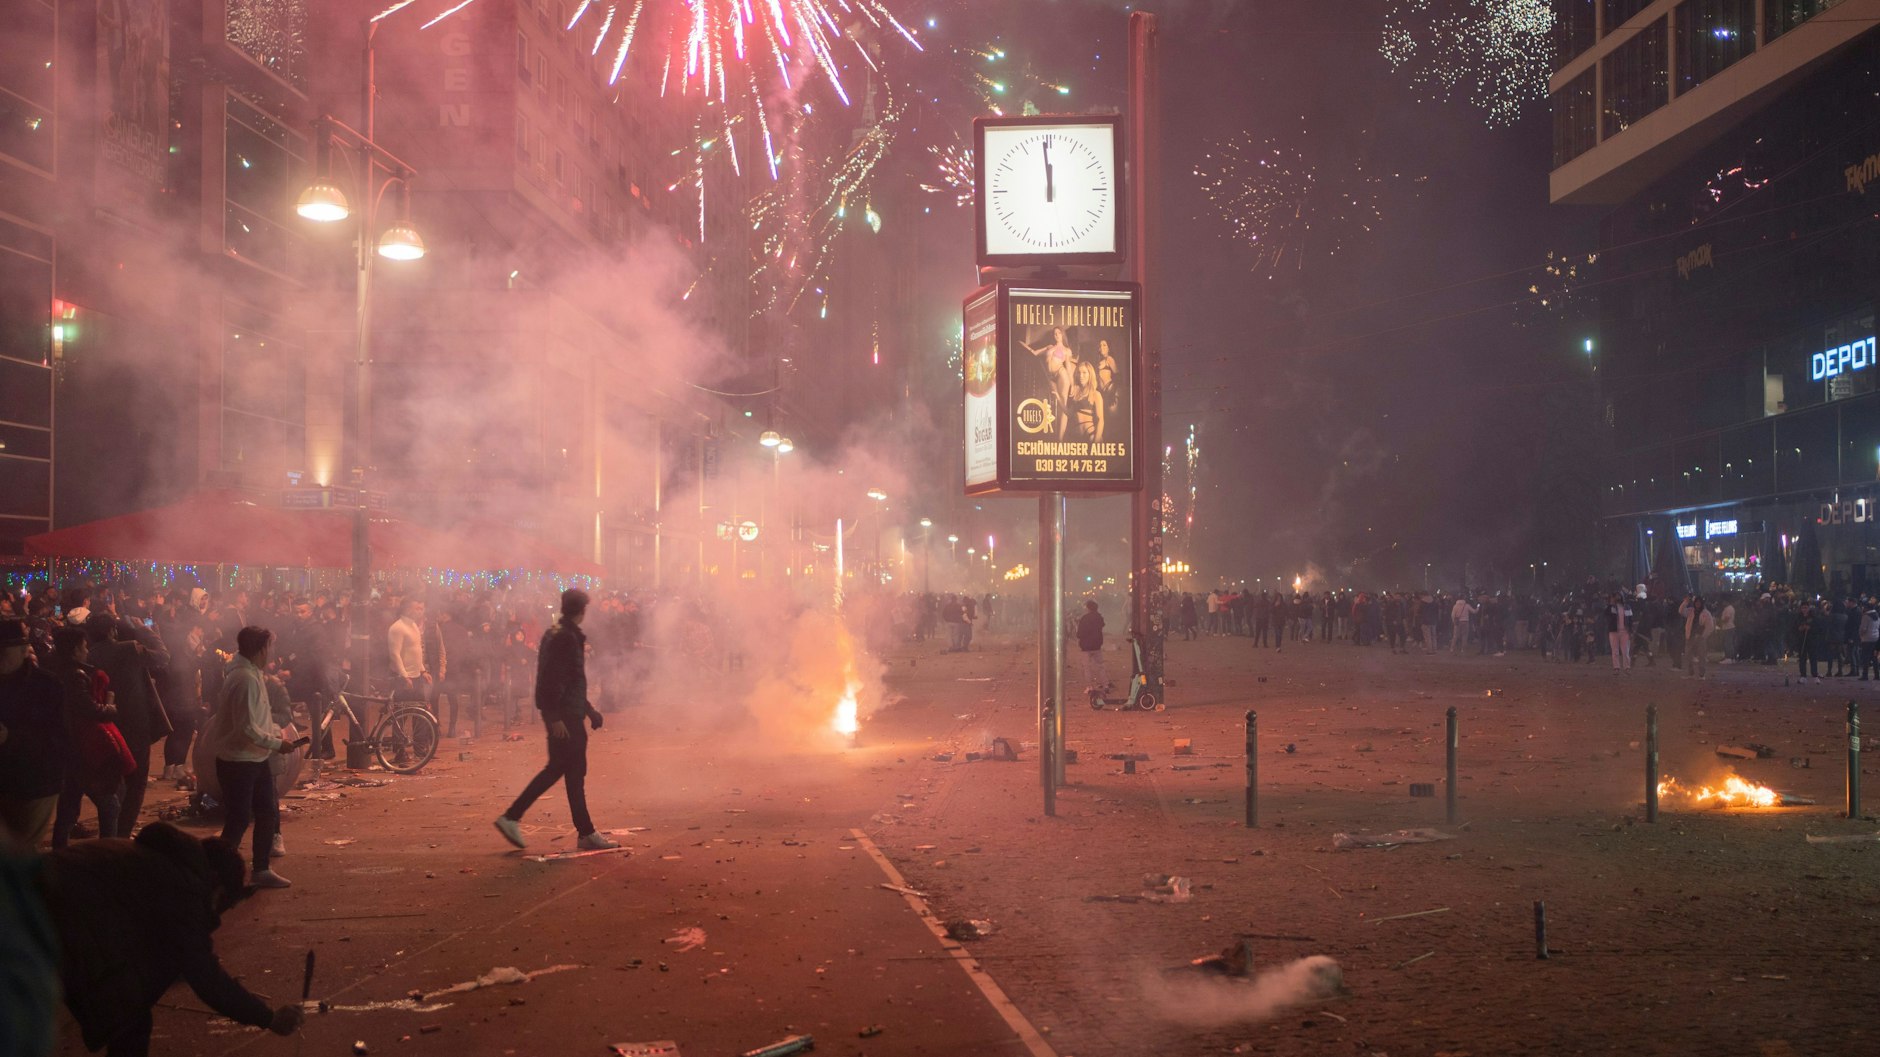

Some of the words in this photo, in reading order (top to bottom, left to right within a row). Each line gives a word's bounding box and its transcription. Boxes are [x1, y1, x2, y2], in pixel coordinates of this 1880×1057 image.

[1016, 304, 1054, 326] ANGELS
[1061, 305, 1125, 327] TABLEDANCE
[1017, 440, 1088, 456] SCHÖNHAUSER
[1090, 443, 1116, 456] ALLEE
[1118, 443, 1126, 457] 5
[1035, 459, 1054, 472] 030
[1055, 459, 1068, 472] 92
[1070, 460, 1080, 472] 14
[1081, 460, 1093, 472] 76
[1094, 460, 1107, 472] 23
[1820, 498, 1877, 526] DEPOT
